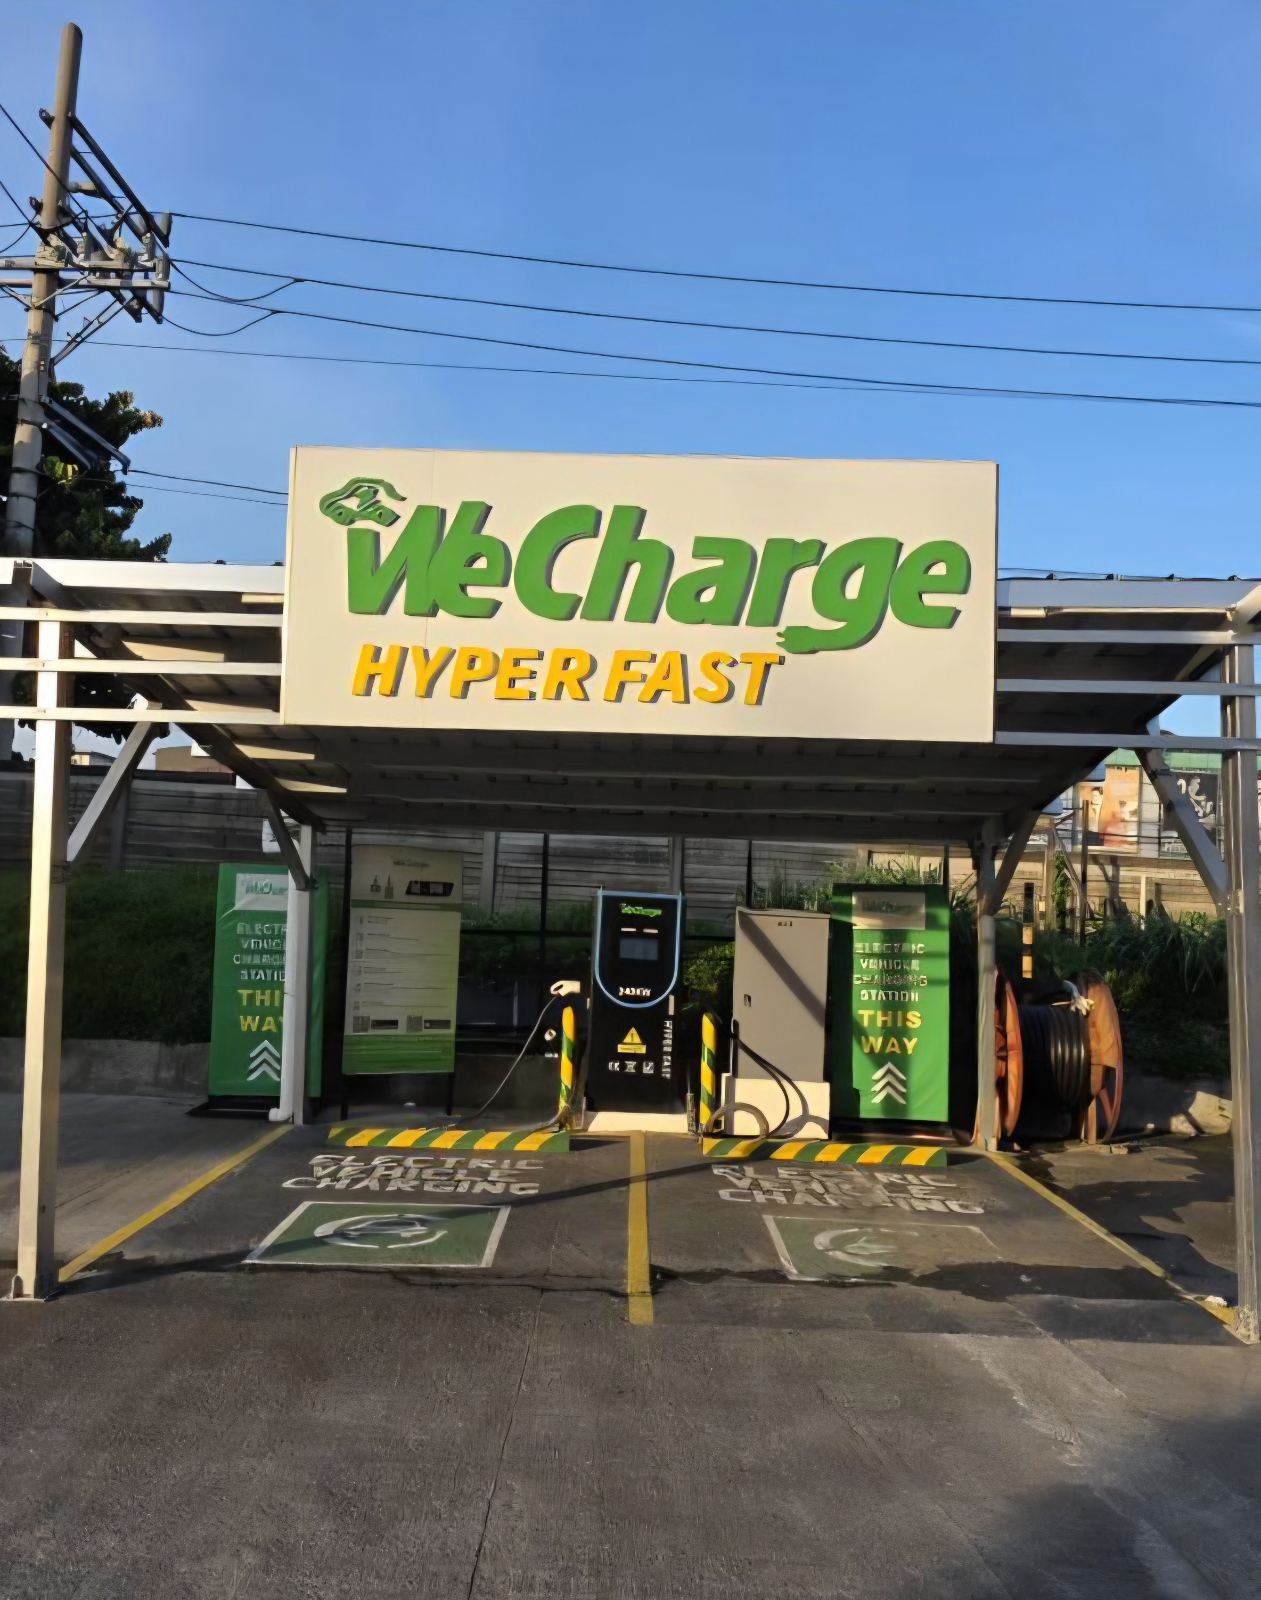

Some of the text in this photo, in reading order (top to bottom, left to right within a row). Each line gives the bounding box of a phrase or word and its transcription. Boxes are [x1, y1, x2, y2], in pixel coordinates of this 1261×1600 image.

[346, 500, 971, 655] WeCharge
[237, 989, 280, 1007] THI
[239, 1015, 283, 1033] WA
[857, 1009, 922, 1029] THIS
[861, 1035, 918, 1055] WAY
